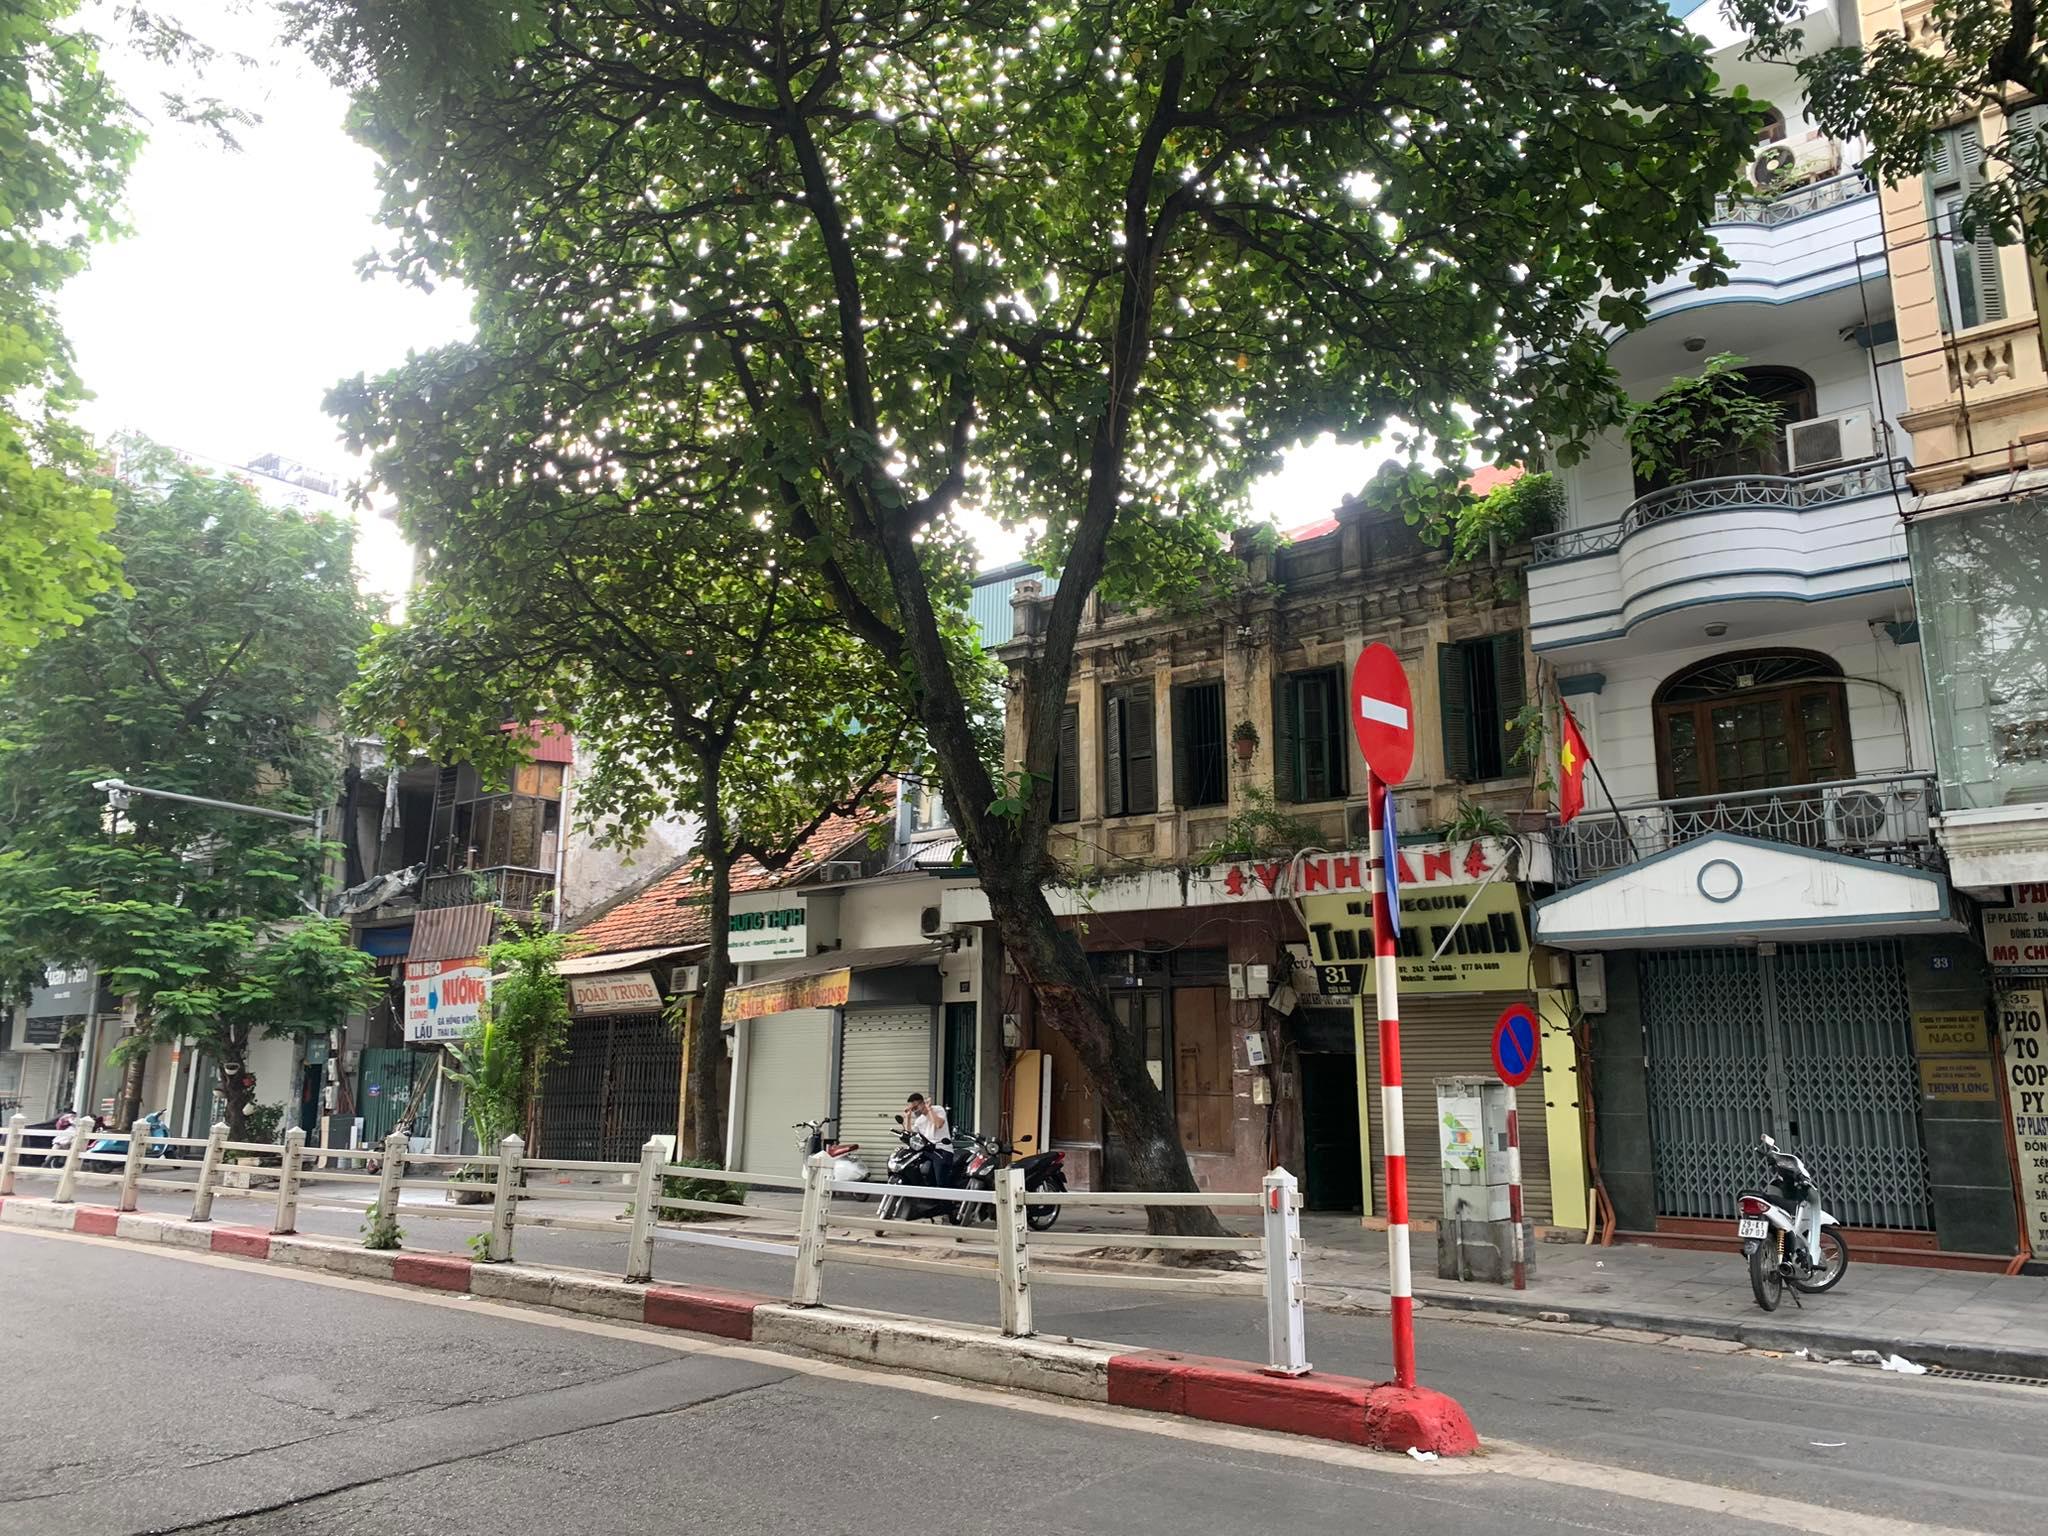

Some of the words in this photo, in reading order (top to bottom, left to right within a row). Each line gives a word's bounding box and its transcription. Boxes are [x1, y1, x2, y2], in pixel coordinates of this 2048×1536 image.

[2018, 884, 2048, 903] PH
[1933, 957, 1948, 968] 33
[1993, 945, 2018, 964] MẠ
[2024, 945, 2048, 960] CH
[1325, 966, 1350, 983] 31
[611, 983, 654, 1001] TRUNG
[2010, 994, 2030, 1004] 35
[2004, 1011, 2041, 1032] PHO
[1929, 1032, 1976, 1043] NACO
[2013, 1037, 2039, 1058] TO
[2012, 1064, 2048, 1086] COP
[1961, 1082, 1989, 1093] LONG
[2020, 1091, 2045, 1113] PY
